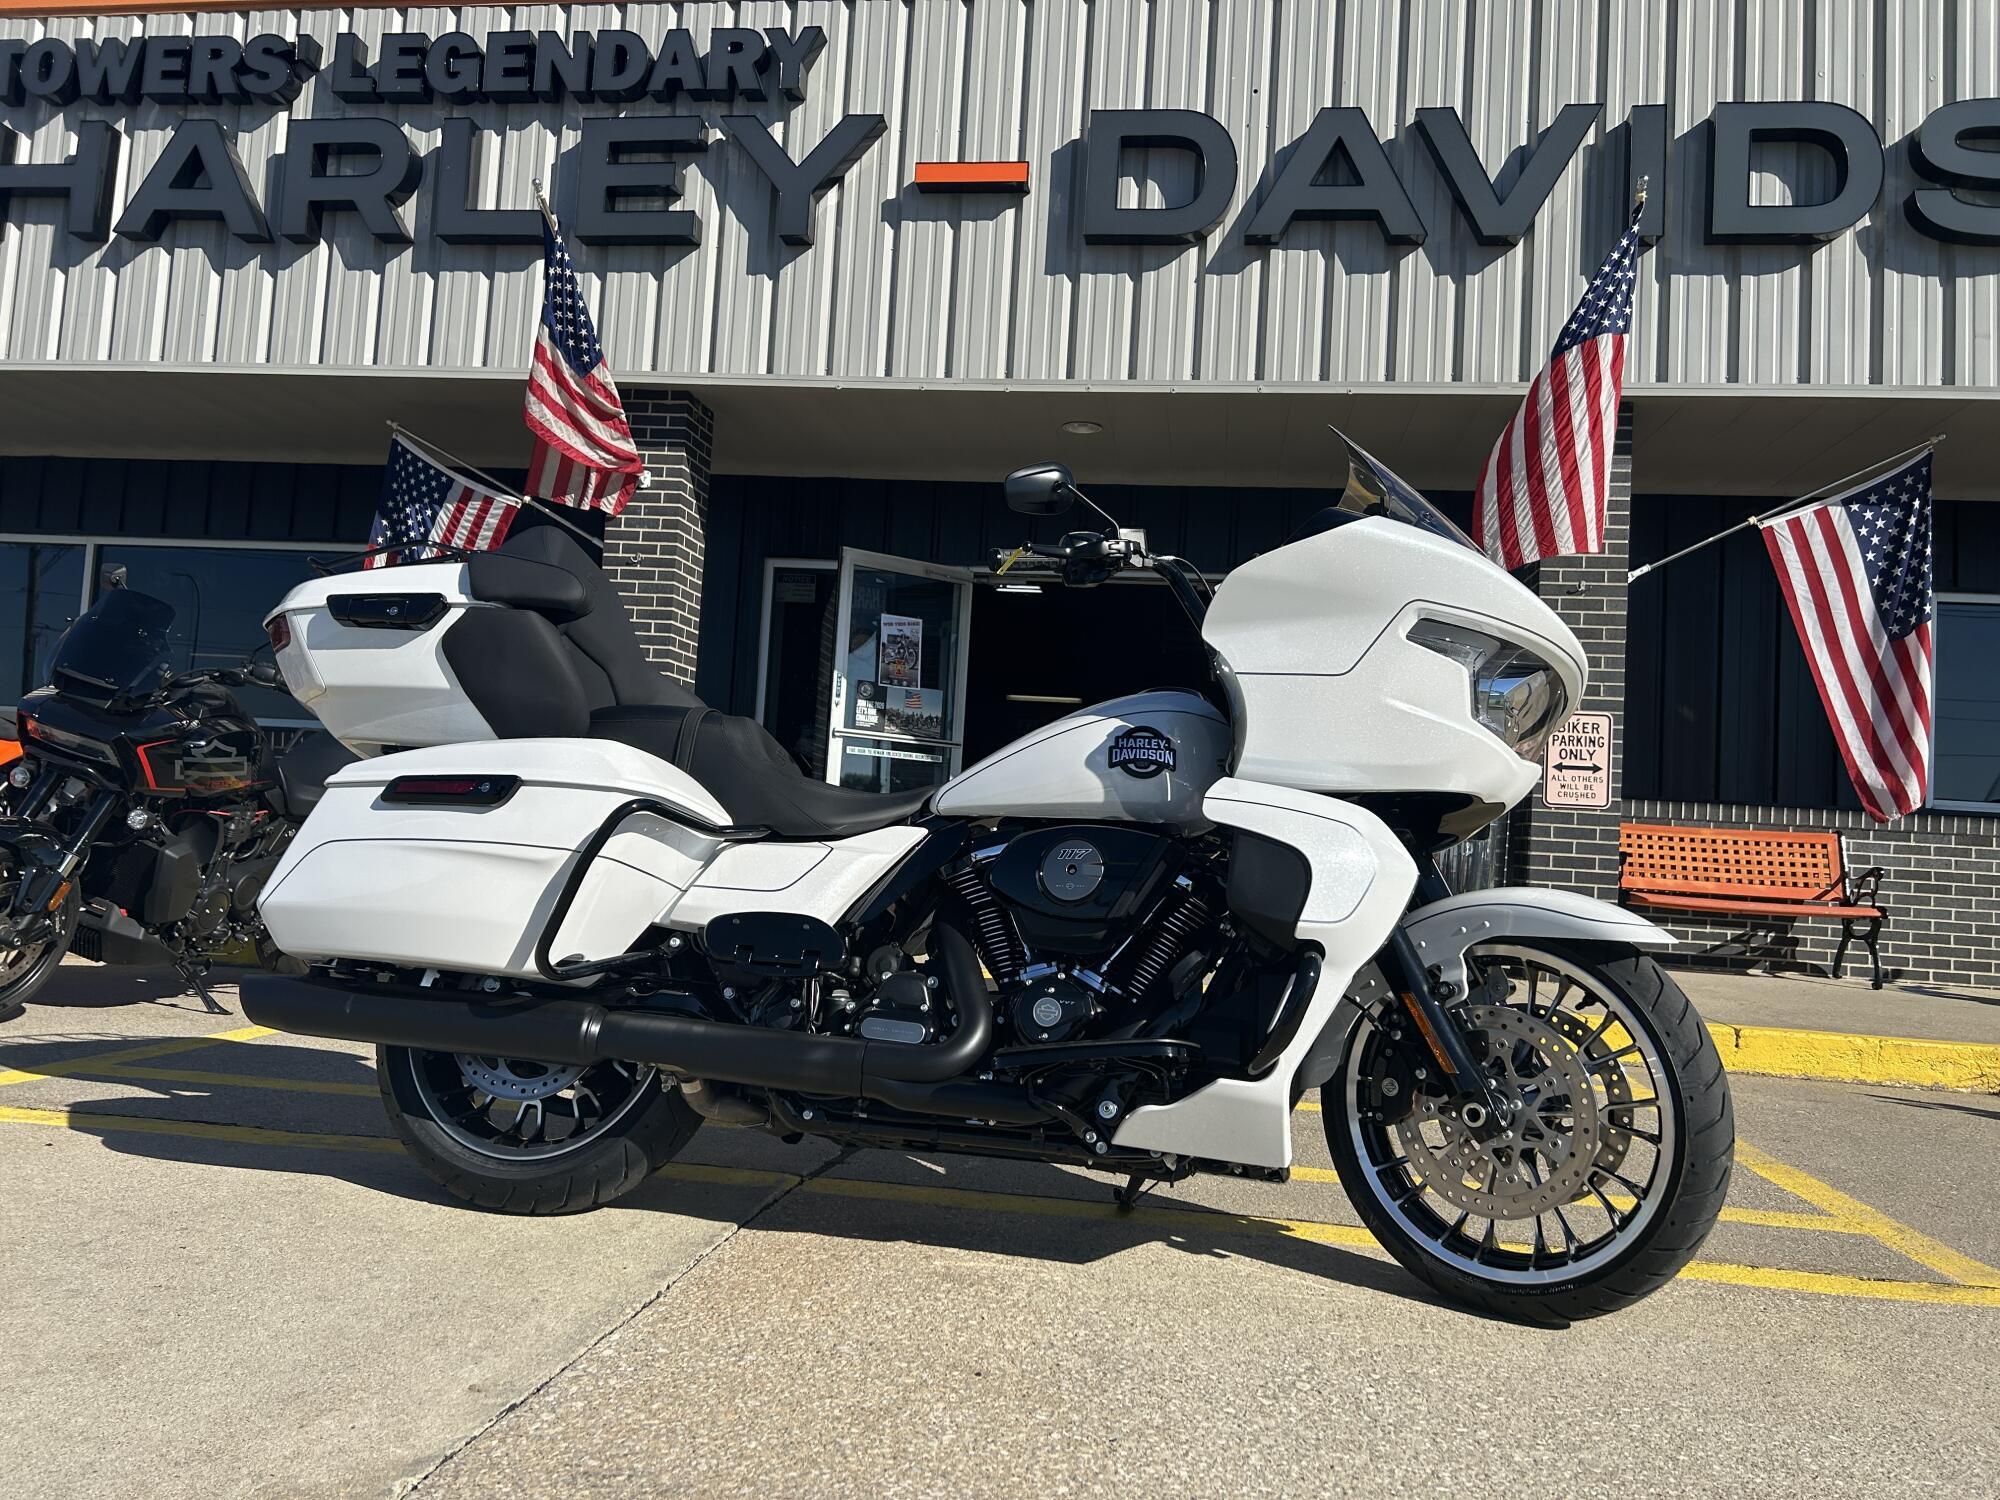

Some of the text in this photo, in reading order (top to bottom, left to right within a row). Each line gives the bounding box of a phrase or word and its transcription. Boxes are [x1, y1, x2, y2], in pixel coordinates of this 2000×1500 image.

[332, 26, 827, 103] LEGENDARY
[1552, 734, 1605, 748] PARKING
[1112, 748, 1174, 766] DAVIDSON
[1559, 748, 1597, 761] ONLY
[1551, 774, 1604, 783] ALL OTHERS
[1557, 790, 1597, 799] CRUSHED
[1057, 848, 1093, 860] 117
